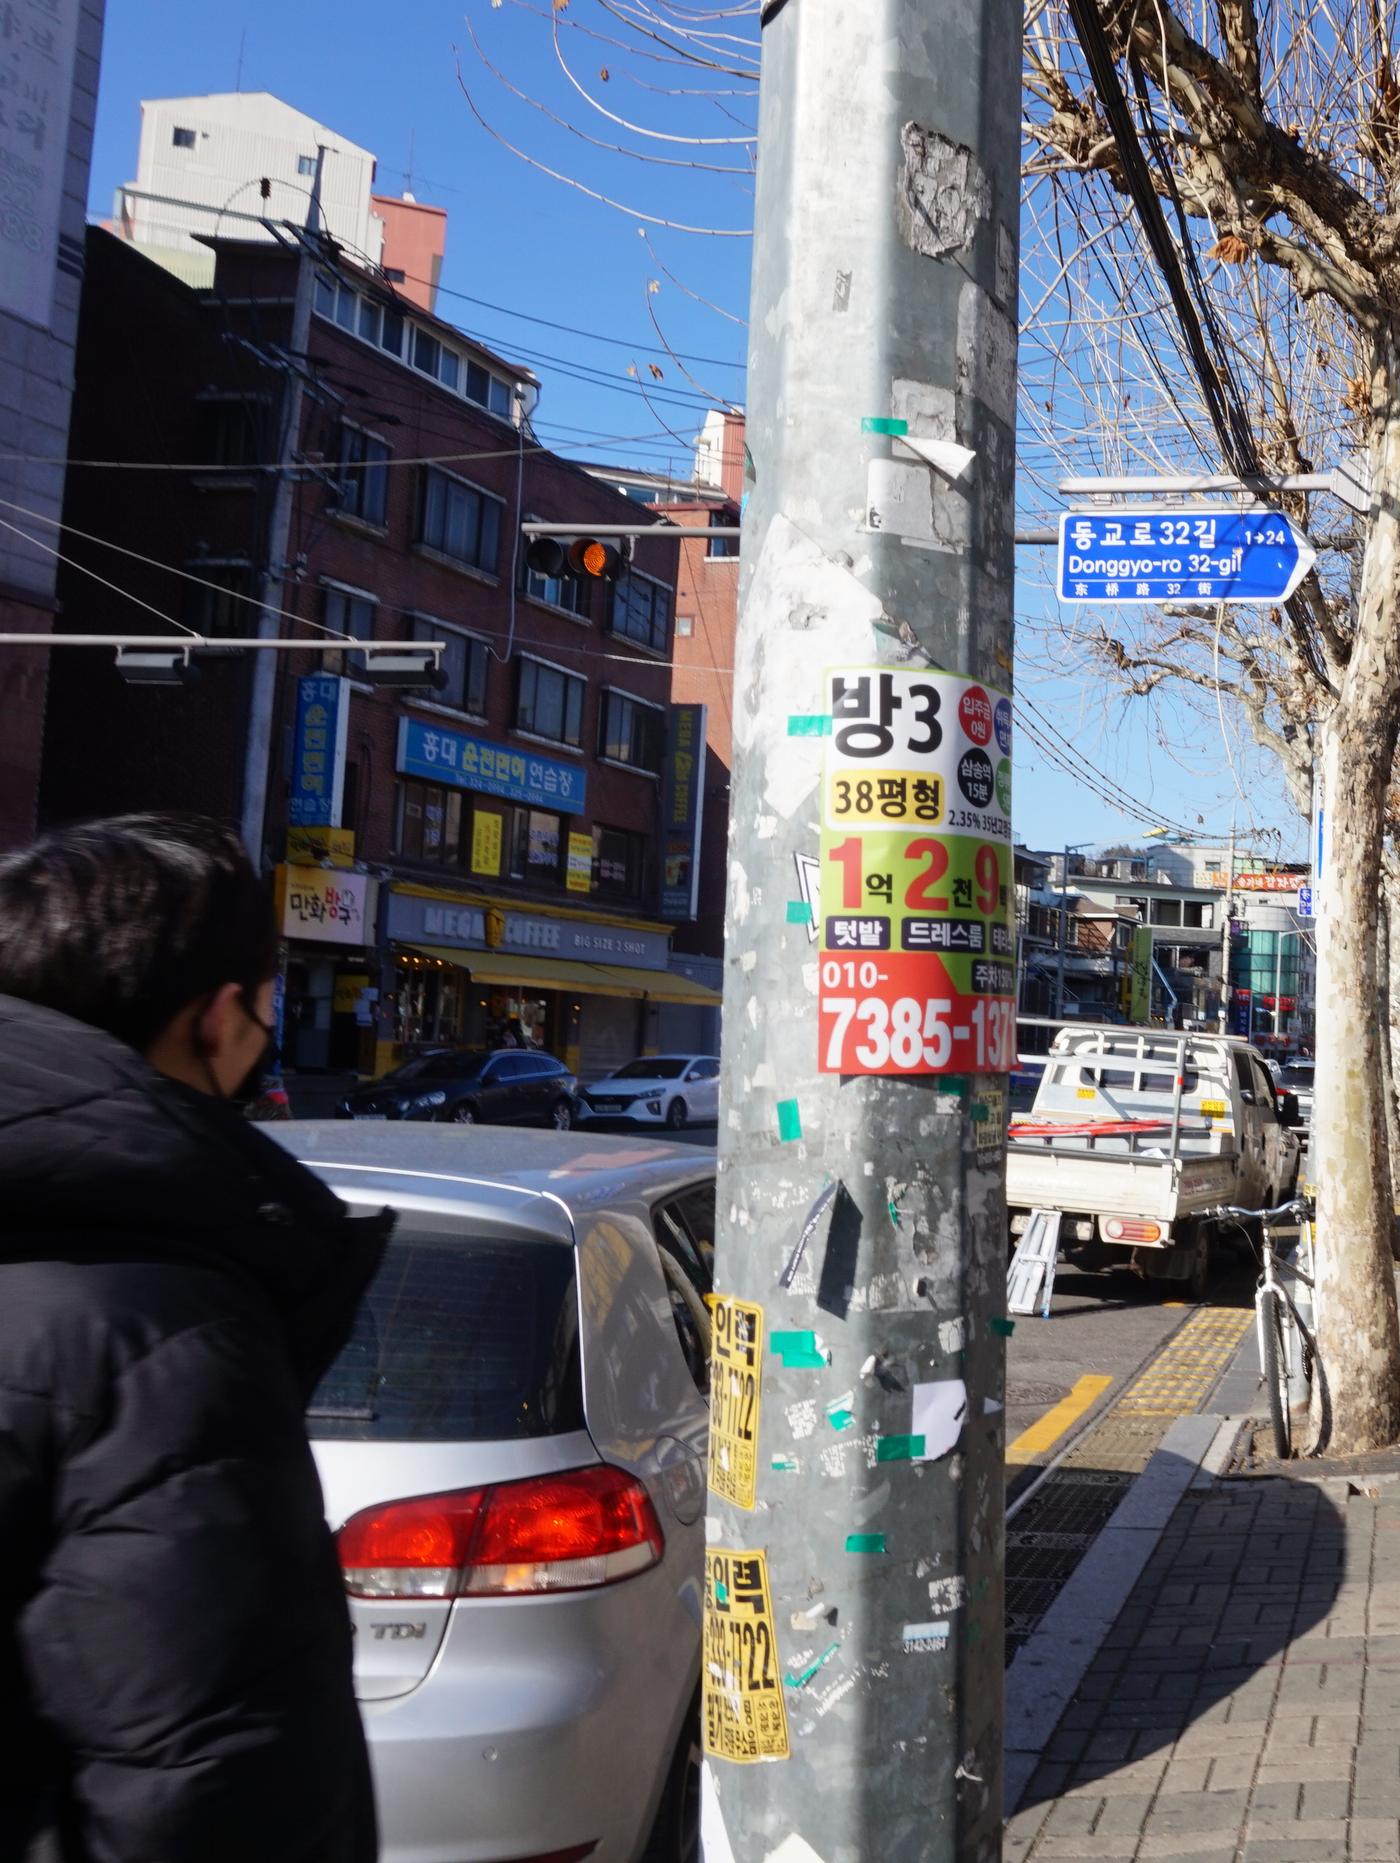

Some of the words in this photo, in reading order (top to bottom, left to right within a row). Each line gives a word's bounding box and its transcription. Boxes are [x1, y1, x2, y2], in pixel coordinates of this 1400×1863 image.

[1070, 519, 1217, 550] 동교로32길
[1069, 555, 1182, 577] Donggyo-ro
[1188, 554, 1242, 576] 32-gil
[831, 672, 944, 759] 방3
[963, 695, 991, 719] 입주금
[970, 718, 987, 740] 0원
[422, 731, 457, 767] 홍대
[462, 741, 527, 785] 운전면허
[529, 760, 574, 797] 연습장
[835, 776, 941, 821] 38평형
[948, 809, 981, 831] 2.35%
[574, 934, 592, 947] BIG
[624, 940, 645, 956] SHOT
[834, 920, 883, 946] 텃밭
[908, 922, 983, 947] 드레스룸
[822, 961, 889, 989] 010-
